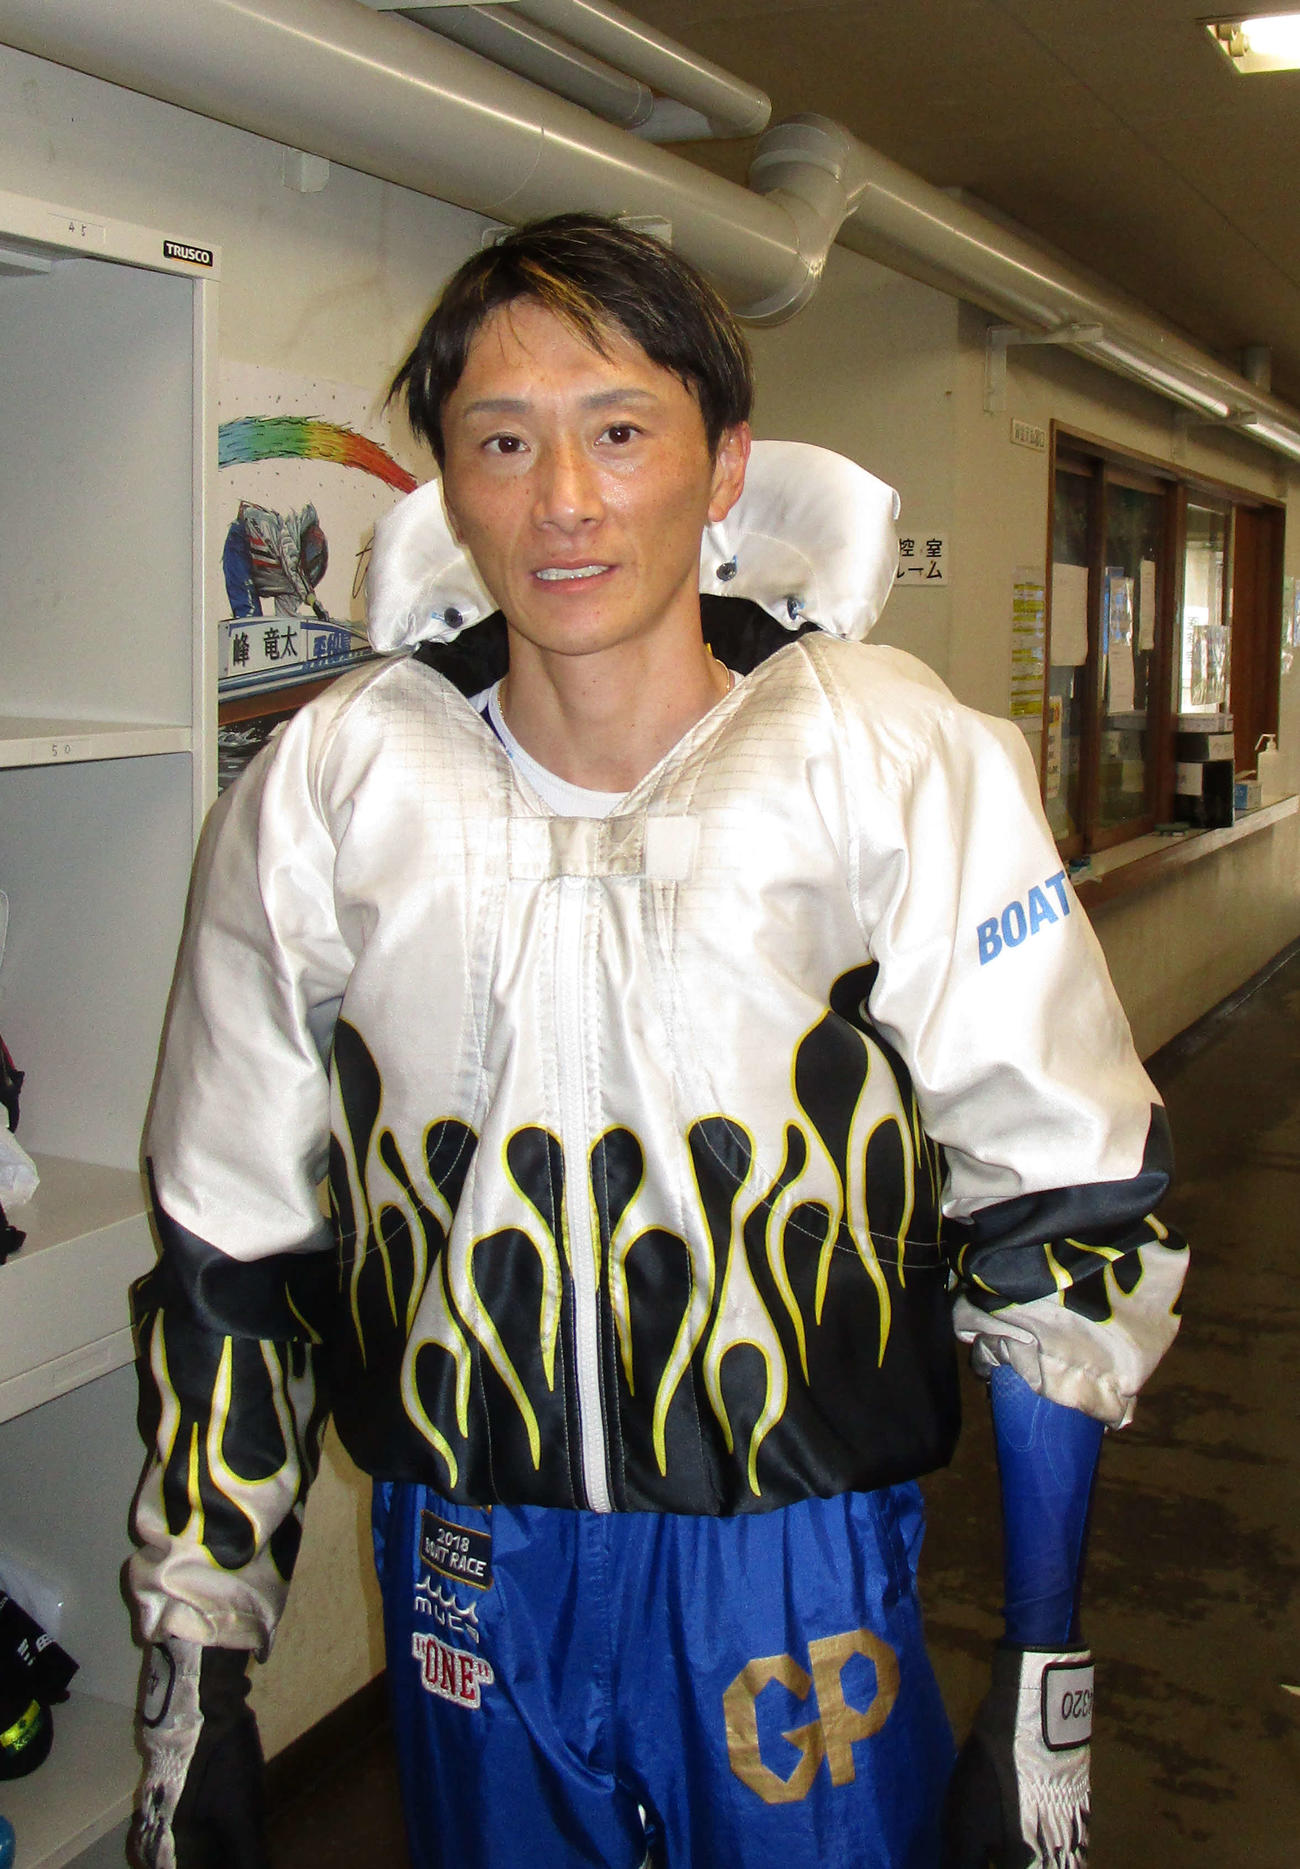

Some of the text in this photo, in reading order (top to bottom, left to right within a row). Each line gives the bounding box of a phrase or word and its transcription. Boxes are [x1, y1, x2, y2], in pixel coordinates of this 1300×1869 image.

[165, 242, 210, 263] TRUSCO
[232, 625, 298, 668] 峰 竜太
[976, 869, 1070, 966] BOAT
[437, 1528, 470, 1553] 2018
[449, 1551, 487, 1577] RACE
[722, 1627, 901, 1806] GP
